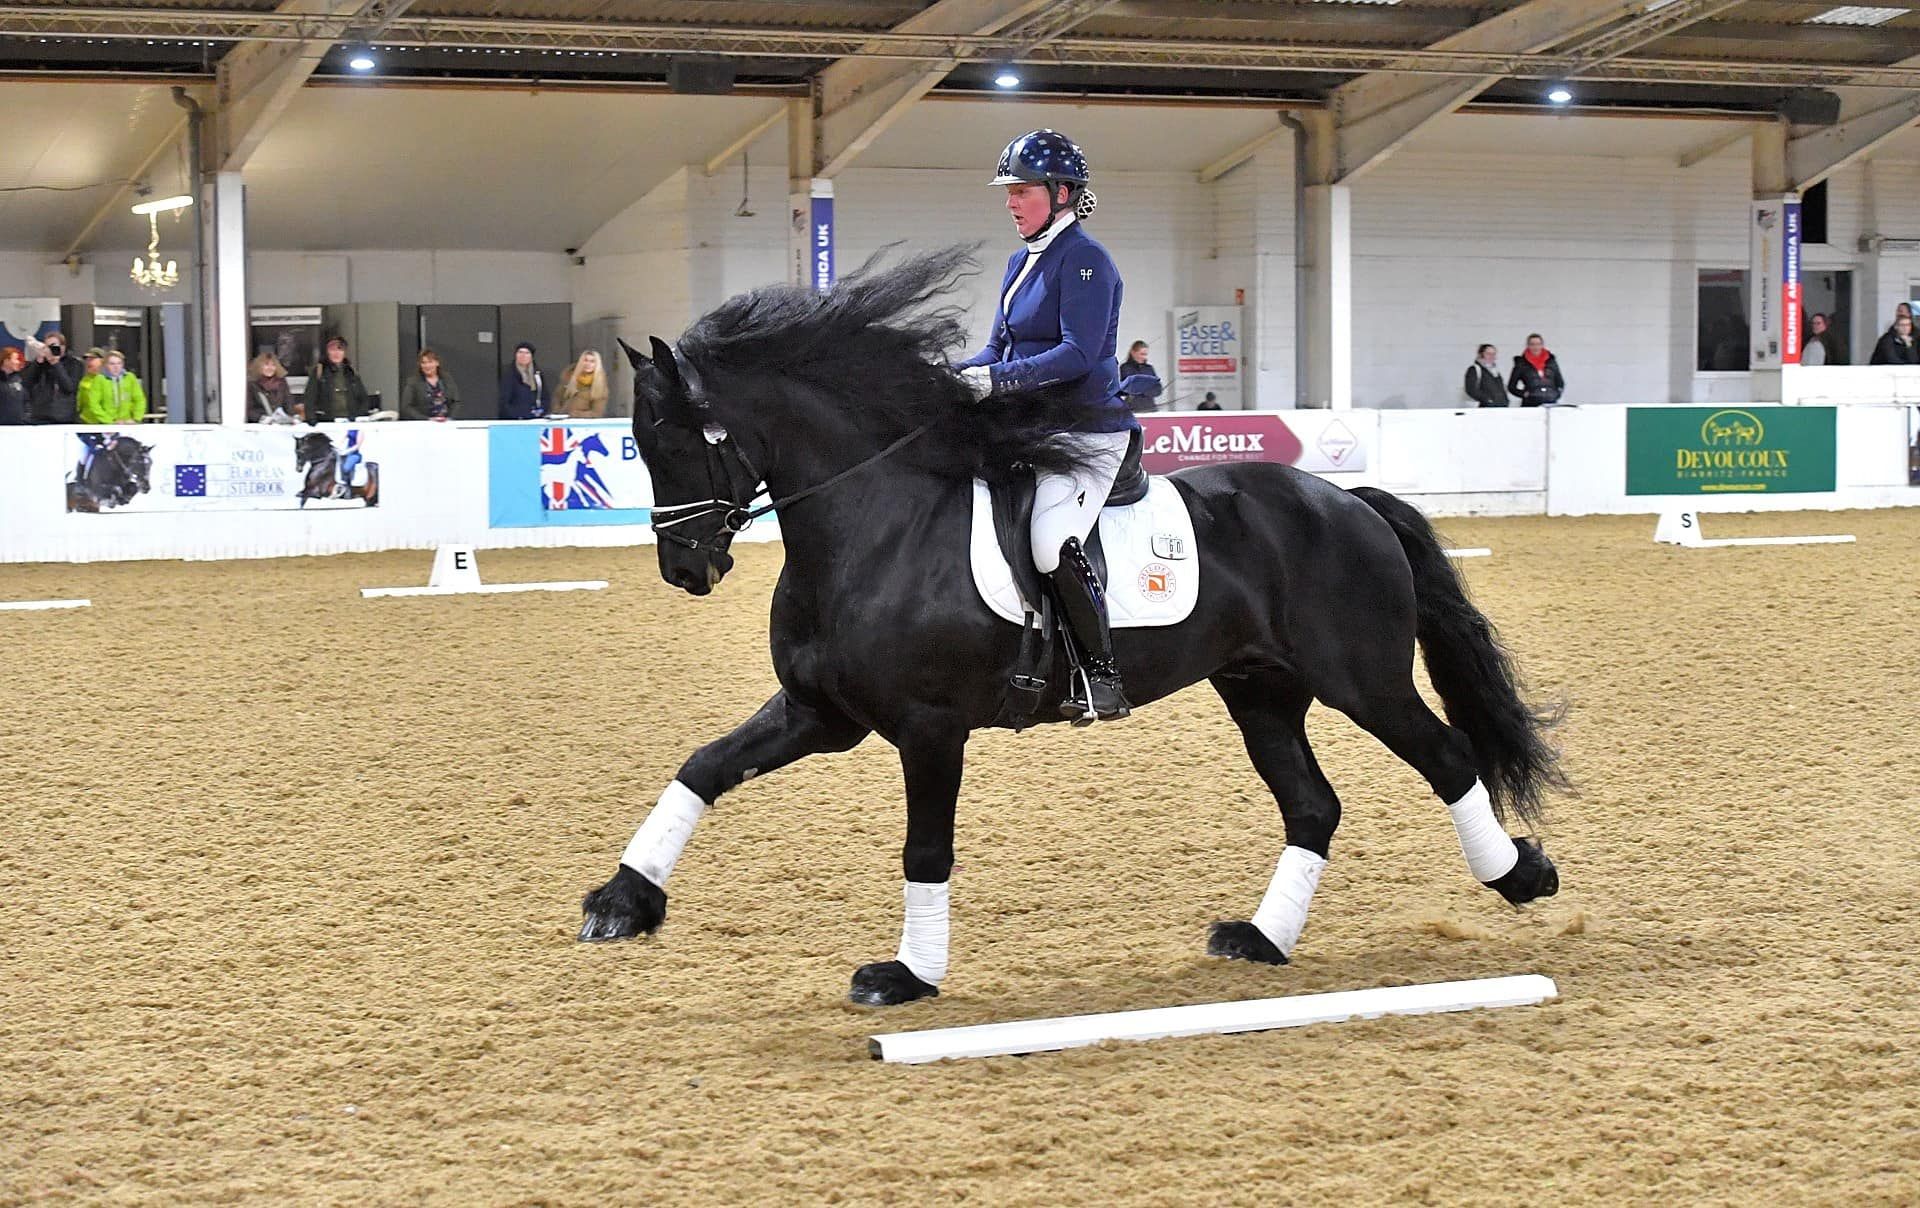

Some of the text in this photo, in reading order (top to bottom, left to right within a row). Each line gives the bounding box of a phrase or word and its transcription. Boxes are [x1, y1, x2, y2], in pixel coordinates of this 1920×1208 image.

[818, 224, 829, 247] UK
[1787, 213, 1798, 355] EQUINE AMERICA UK
[1181, 341, 1229, 355] EXCEL
[1142, 425, 1265, 454] LeMieux
[1681, 513, 1692, 528] S
[454, 551, 468, 570] E
